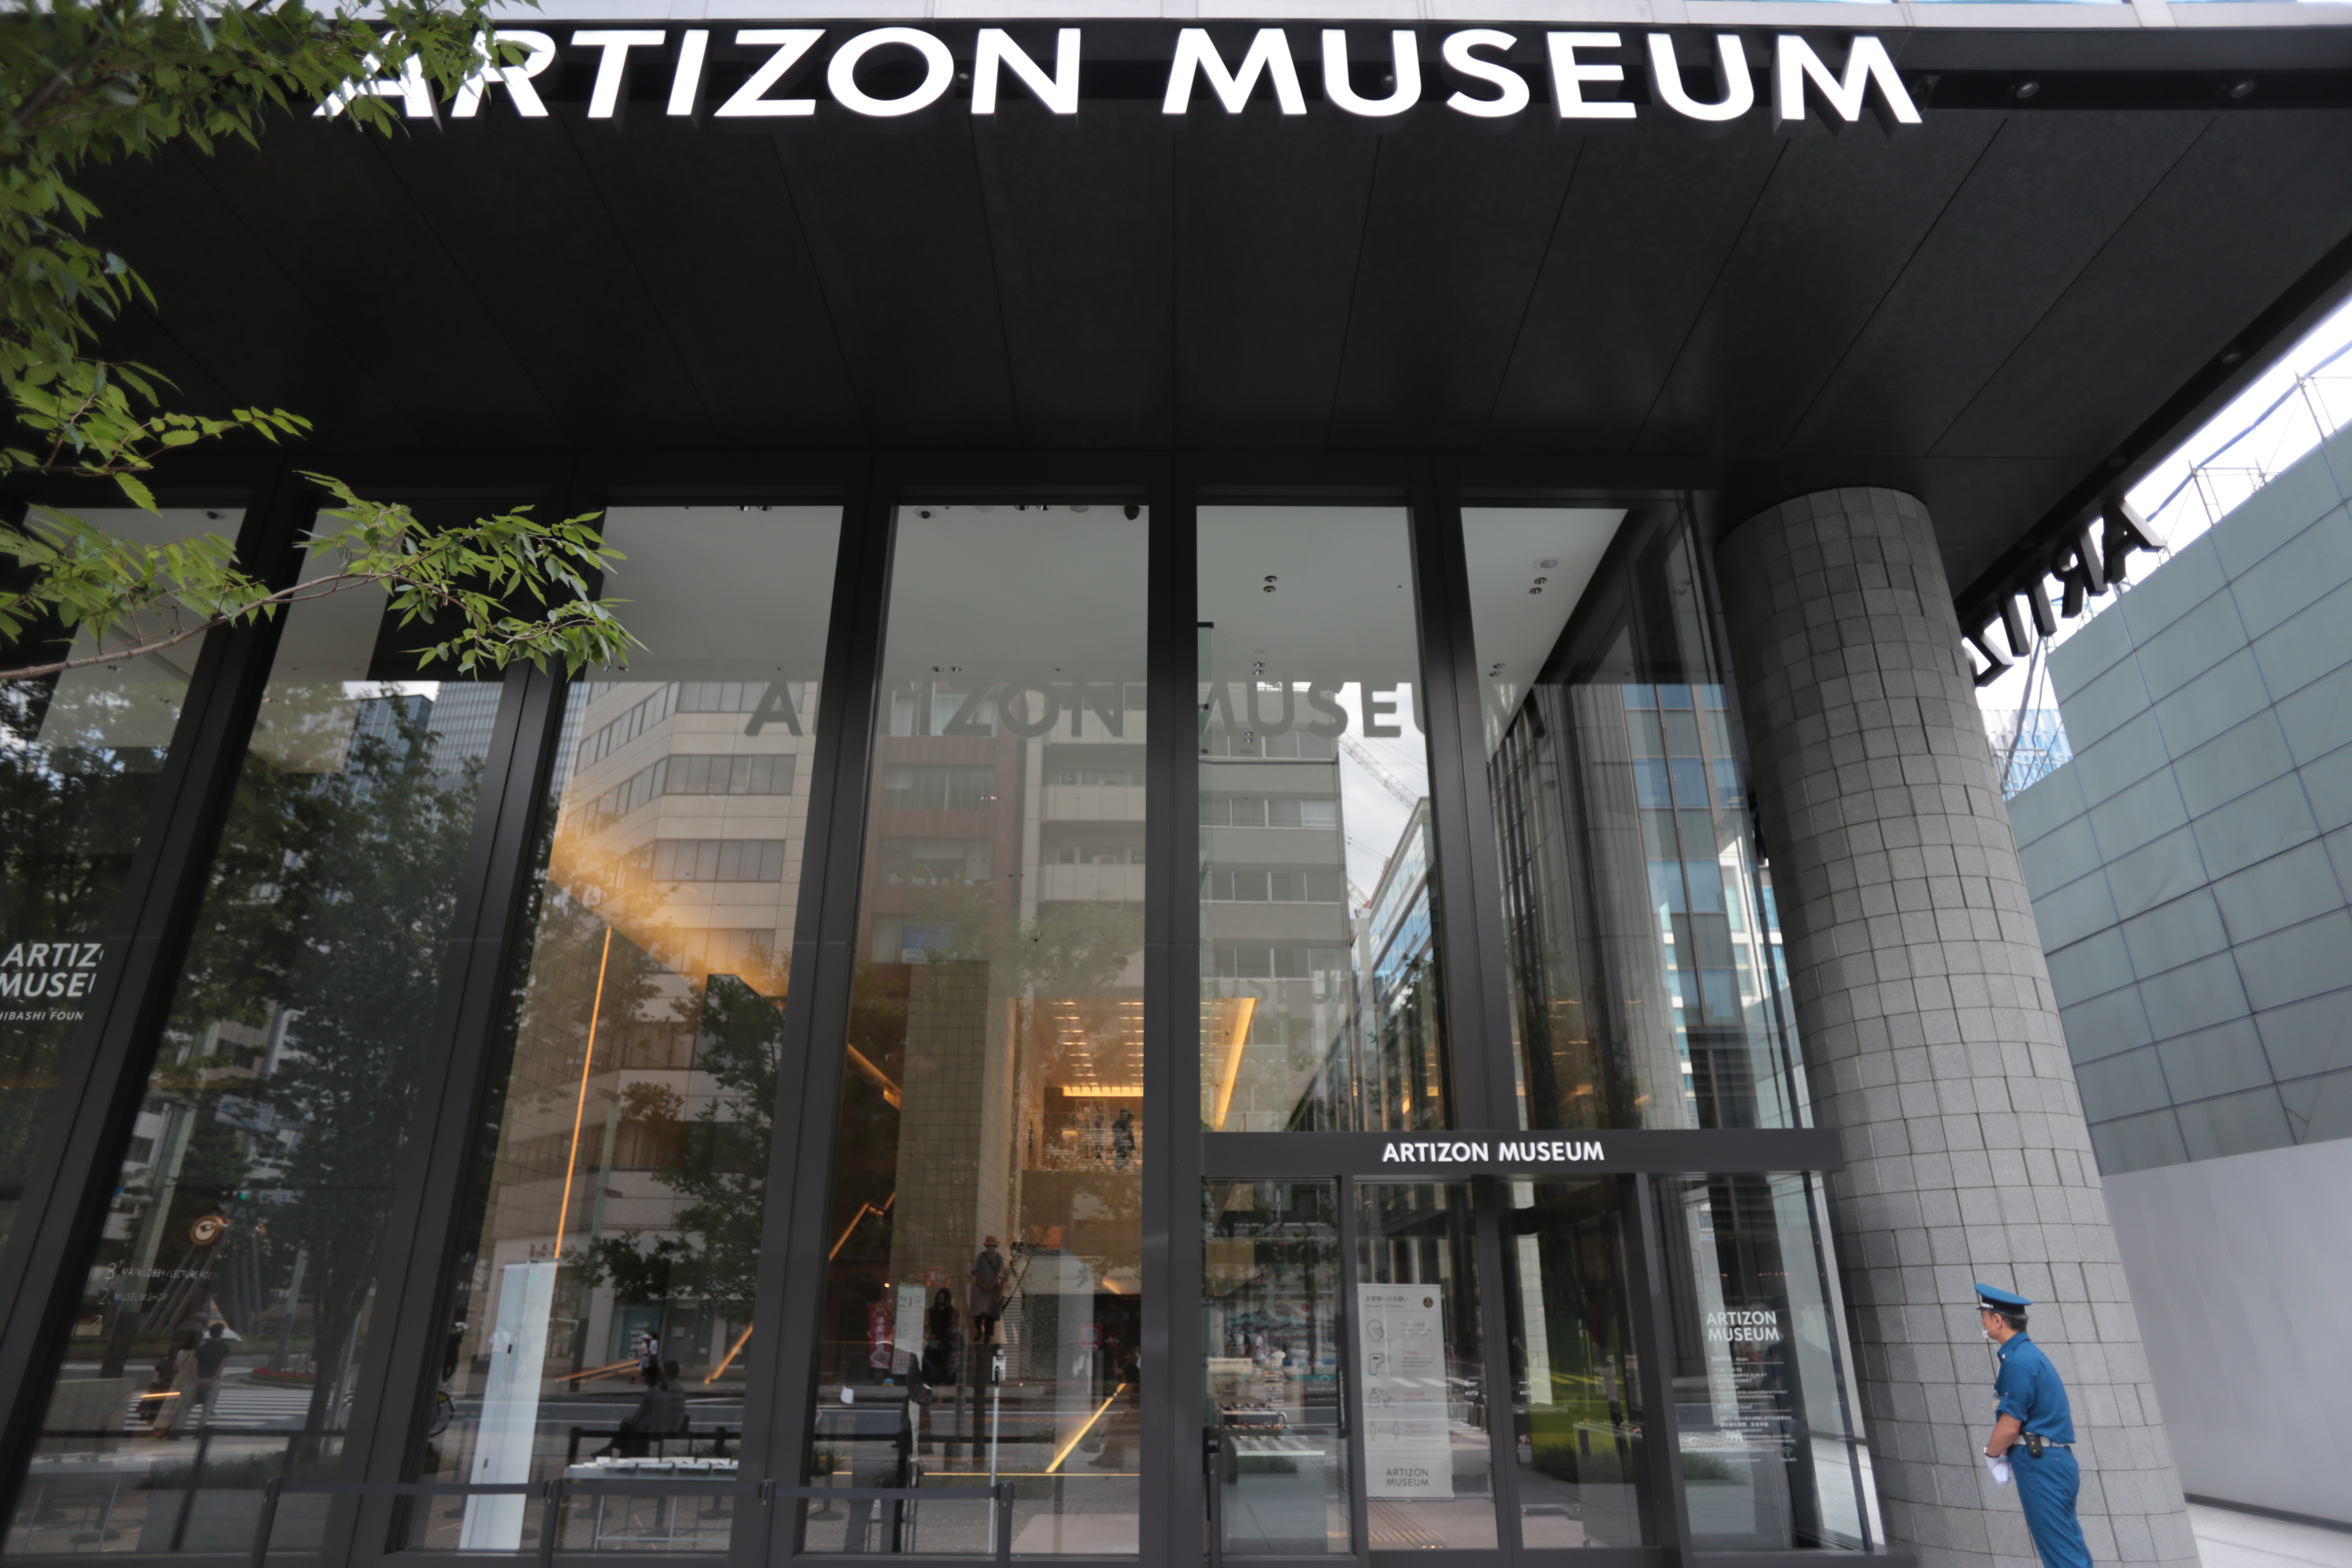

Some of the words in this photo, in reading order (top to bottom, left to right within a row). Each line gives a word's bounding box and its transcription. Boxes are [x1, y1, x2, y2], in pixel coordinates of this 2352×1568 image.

[1161, 28, 1923, 124] MUSEUM
[0, 943, 104, 967] ARTIZ
[0, 972, 97, 997] MUSE
[1382, 1142, 1489, 1162] ARTIZON
[1499, 1142, 1605, 1161] MUSEUM
[105, 1263, 116, 1280] 3
[121, 1267, 141, 1277] MAIN
[98, 1288, 109, 1305] 2
[114, 1292, 146, 1301] MUSEUM
[1706, 1311, 1777, 1326] ARTIZON
[1709, 1327, 1779, 1341] MUSEUM
[1386, 1468, 1428, 1476] ARTIZON
[1386, 1478, 1429, 1486] MUSEUM
